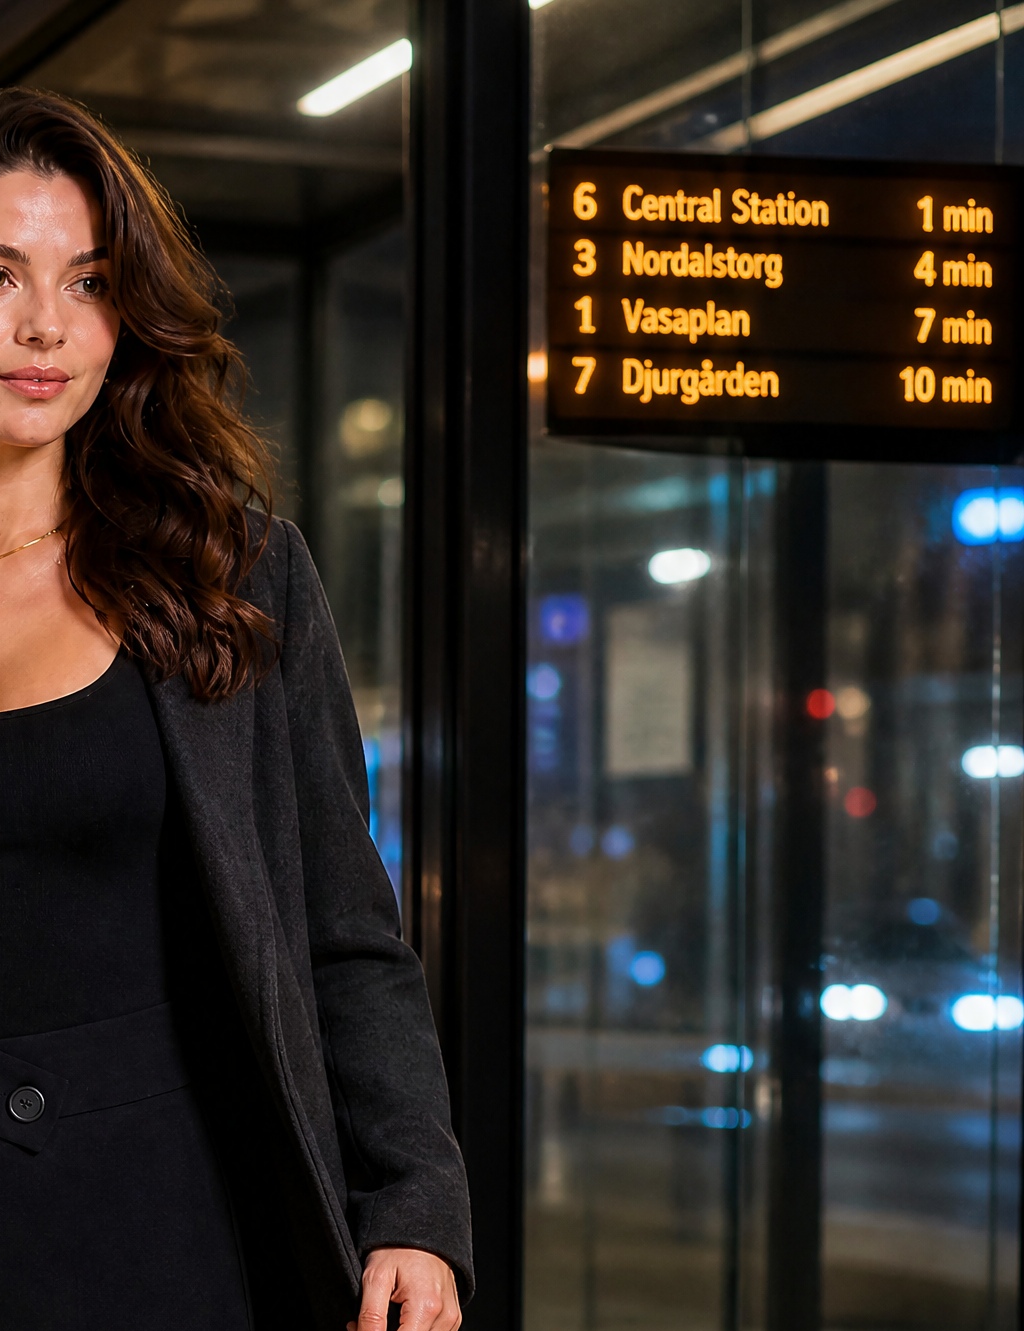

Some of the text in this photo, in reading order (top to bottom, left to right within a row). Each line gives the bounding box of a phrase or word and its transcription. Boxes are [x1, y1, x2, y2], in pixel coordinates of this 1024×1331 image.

[572, 181, 994, 234] 6 Central Station 1 min
[572, 238, 993, 289] 3 Nordalstorg 4 min
[573, 295, 993, 346] 1 Vasaplan 7 min
[571, 356, 993, 405] 7 Djurgården 10 min
